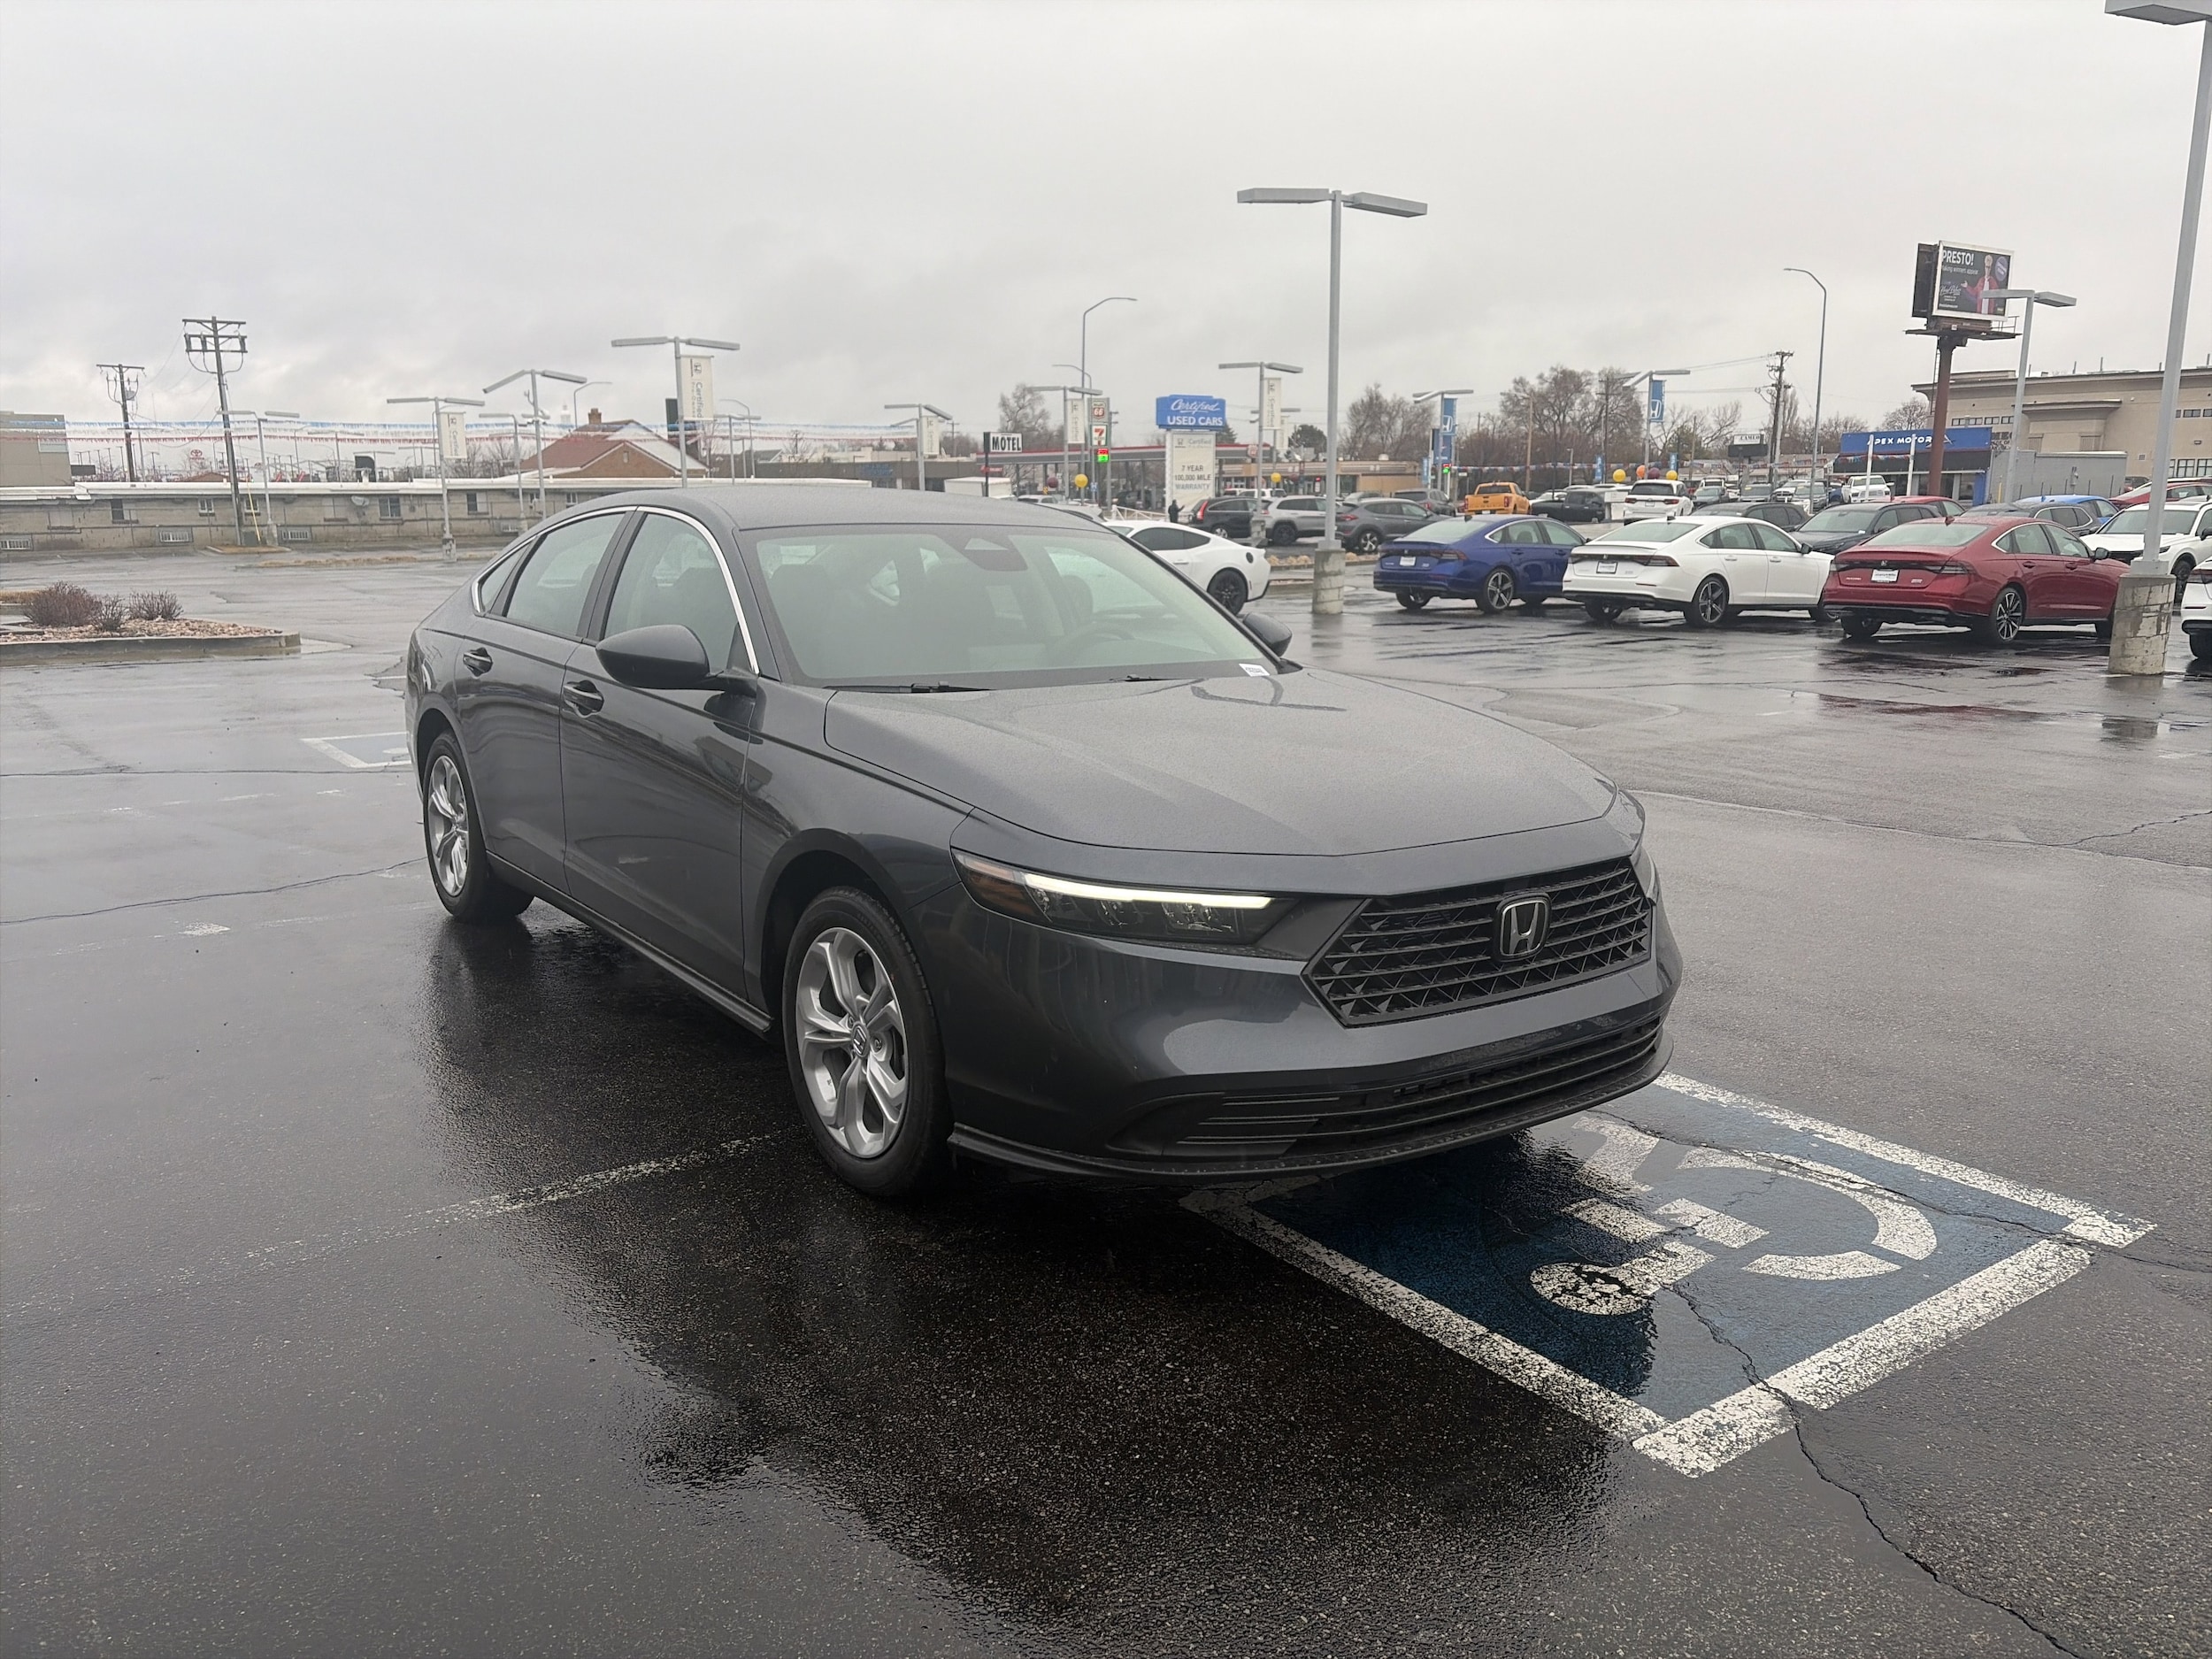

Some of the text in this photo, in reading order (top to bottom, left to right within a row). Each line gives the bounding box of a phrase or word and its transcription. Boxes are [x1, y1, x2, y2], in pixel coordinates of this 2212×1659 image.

[1942, 250, 1974, 265] PRESTO!
[1171, 398, 1221, 415] Certified
[1167, 416, 1223, 426] USED CARS
[992, 436, 1022, 451] MOTEL
